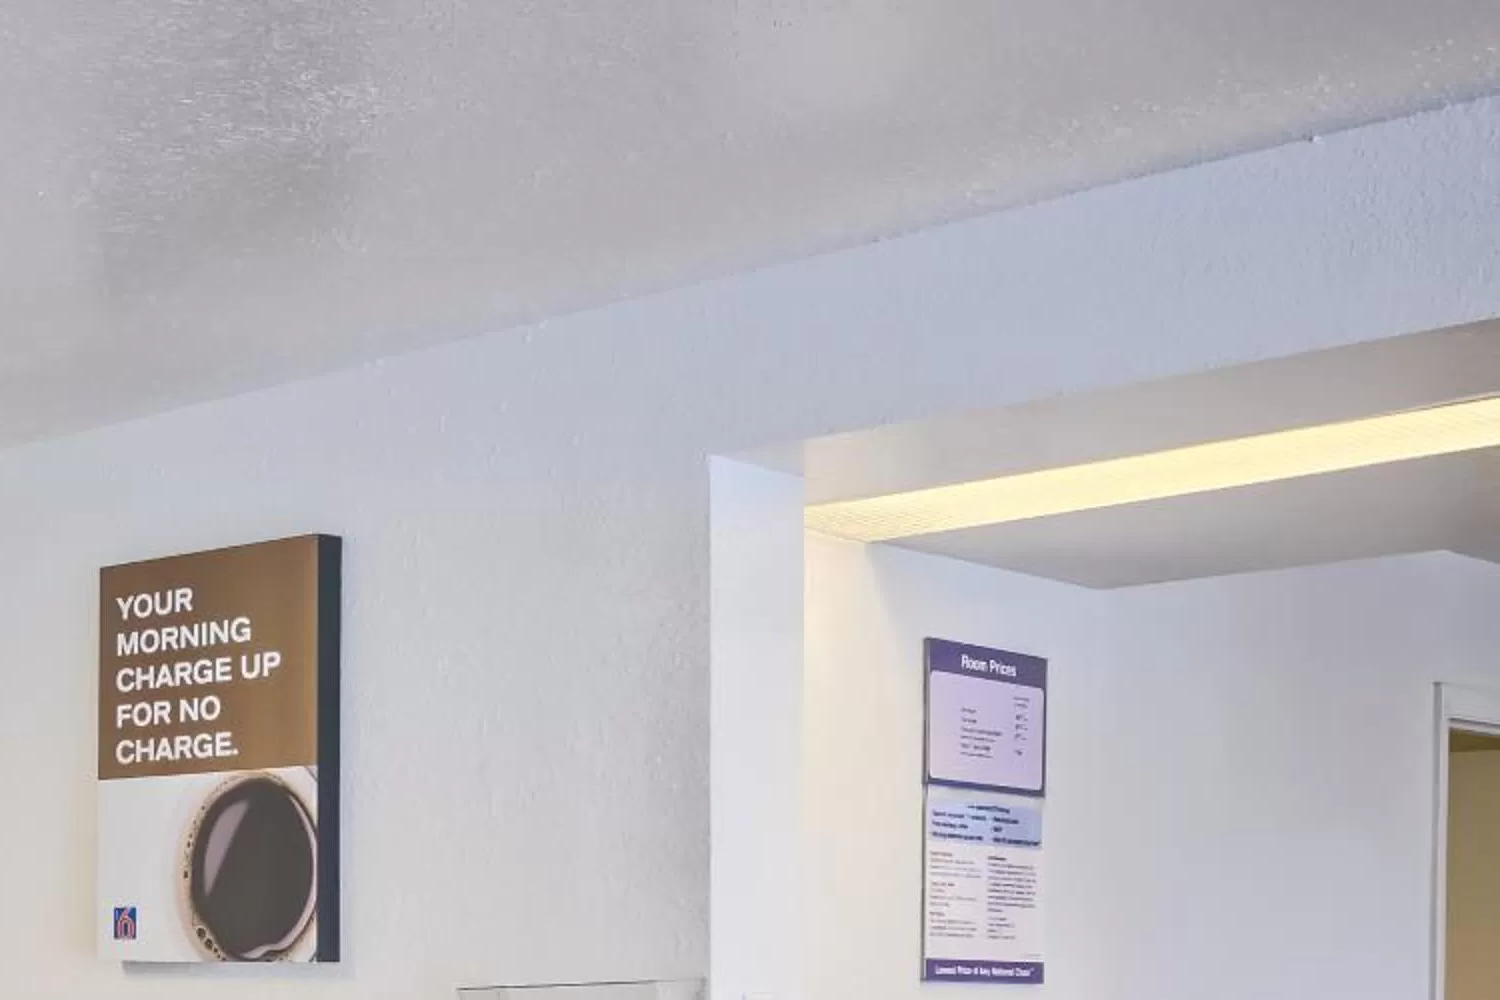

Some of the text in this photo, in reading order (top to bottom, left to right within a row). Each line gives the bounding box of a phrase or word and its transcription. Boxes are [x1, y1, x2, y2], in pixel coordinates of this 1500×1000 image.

[116, 587, 193, 620] YOUR
[116, 616, 251, 656] MORNING
[116, 651, 281, 692] CHARGE UP
[961, 654, 1017, 677] Room Prices
[116, 695, 221, 728] FOR NO
[116, 732, 239, 764] CHARGE.
